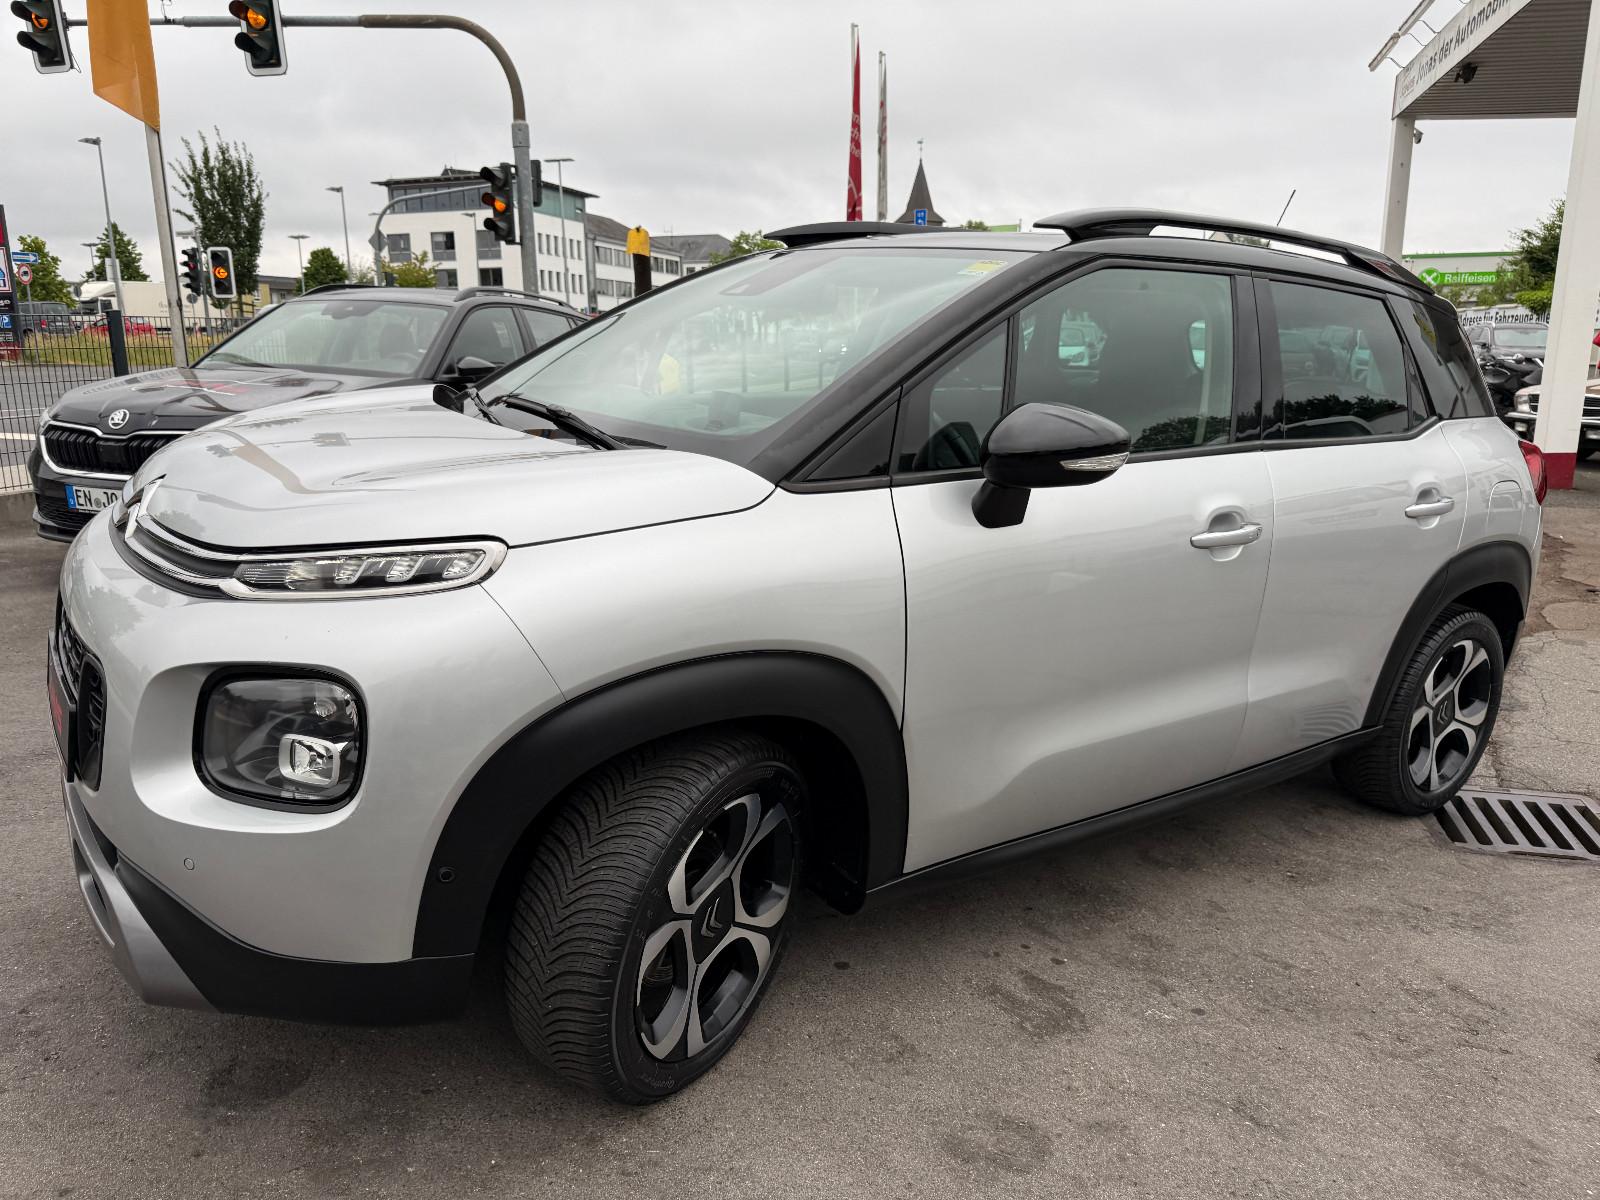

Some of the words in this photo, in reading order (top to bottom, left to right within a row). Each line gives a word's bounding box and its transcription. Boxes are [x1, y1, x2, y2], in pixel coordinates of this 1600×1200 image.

[1416, 52, 1437, 85] Jonas
[1438, 37, 1454, 65] der
[1444, 273, 1496, 283] Raiffeisen
[1482, 311, 1493, 322] für
[1495, 310, 1533, 324] Fahrzeuge
[75, 489, 93, 507] EN
